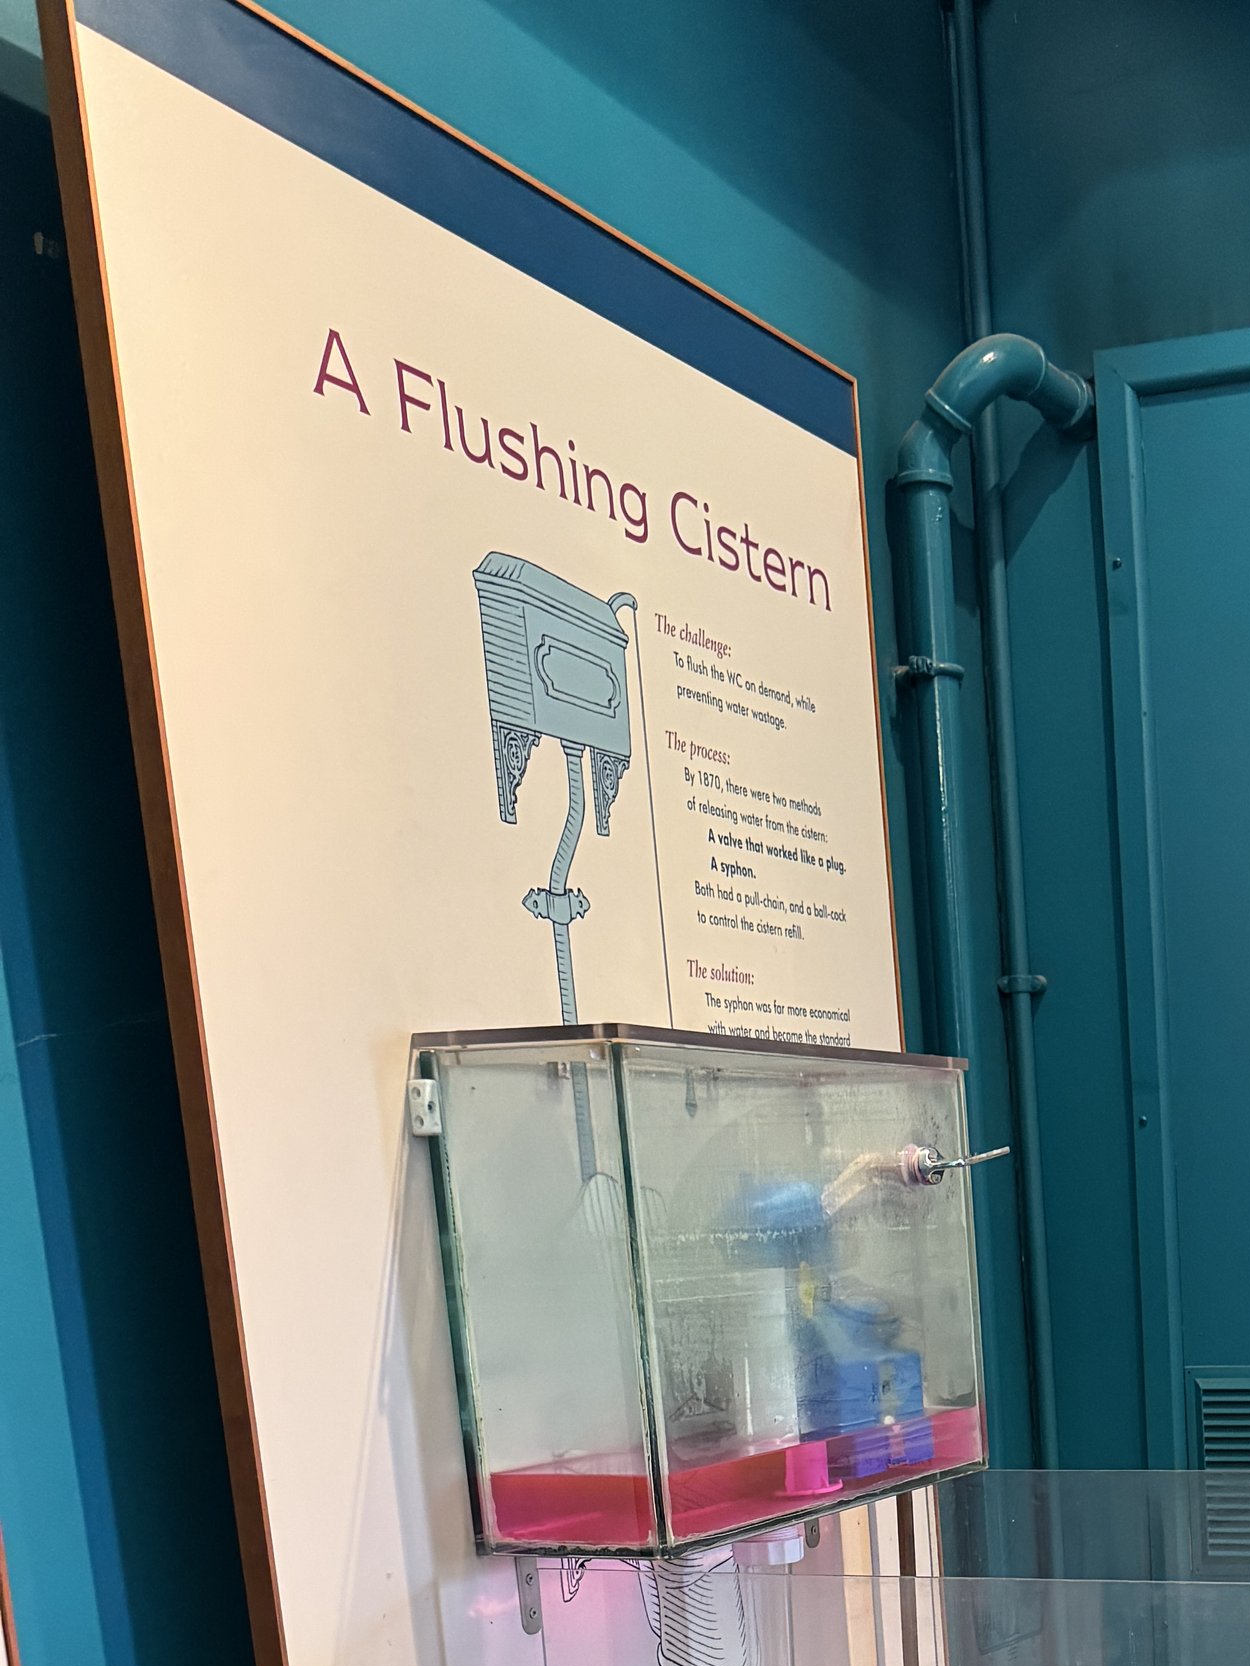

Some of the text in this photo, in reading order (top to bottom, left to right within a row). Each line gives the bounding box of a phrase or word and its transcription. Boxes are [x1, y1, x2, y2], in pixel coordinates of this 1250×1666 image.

[313, 328, 832, 611] A Flushing Cistern
[655, 613, 731, 660] The challenge:
[673, 651, 816, 713] To flush the WC on demand, while
[677, 685, 787, 731] preventing water wastage.
[665, 730, 730, 765] The process:
[684, 767, 822, 816] By 1870, there were two methods
[687, 796, 828, 843] of releasing water from the cistern:
[708, 828, 846, 875] A valve that worked like a plug.
[711, 856, 756, 879] A syphon.
[695, 880, 846, 922] Both had a pull-chain, and a ball-cock
[705, 992, 850, 1022] The syphon was far more economical
